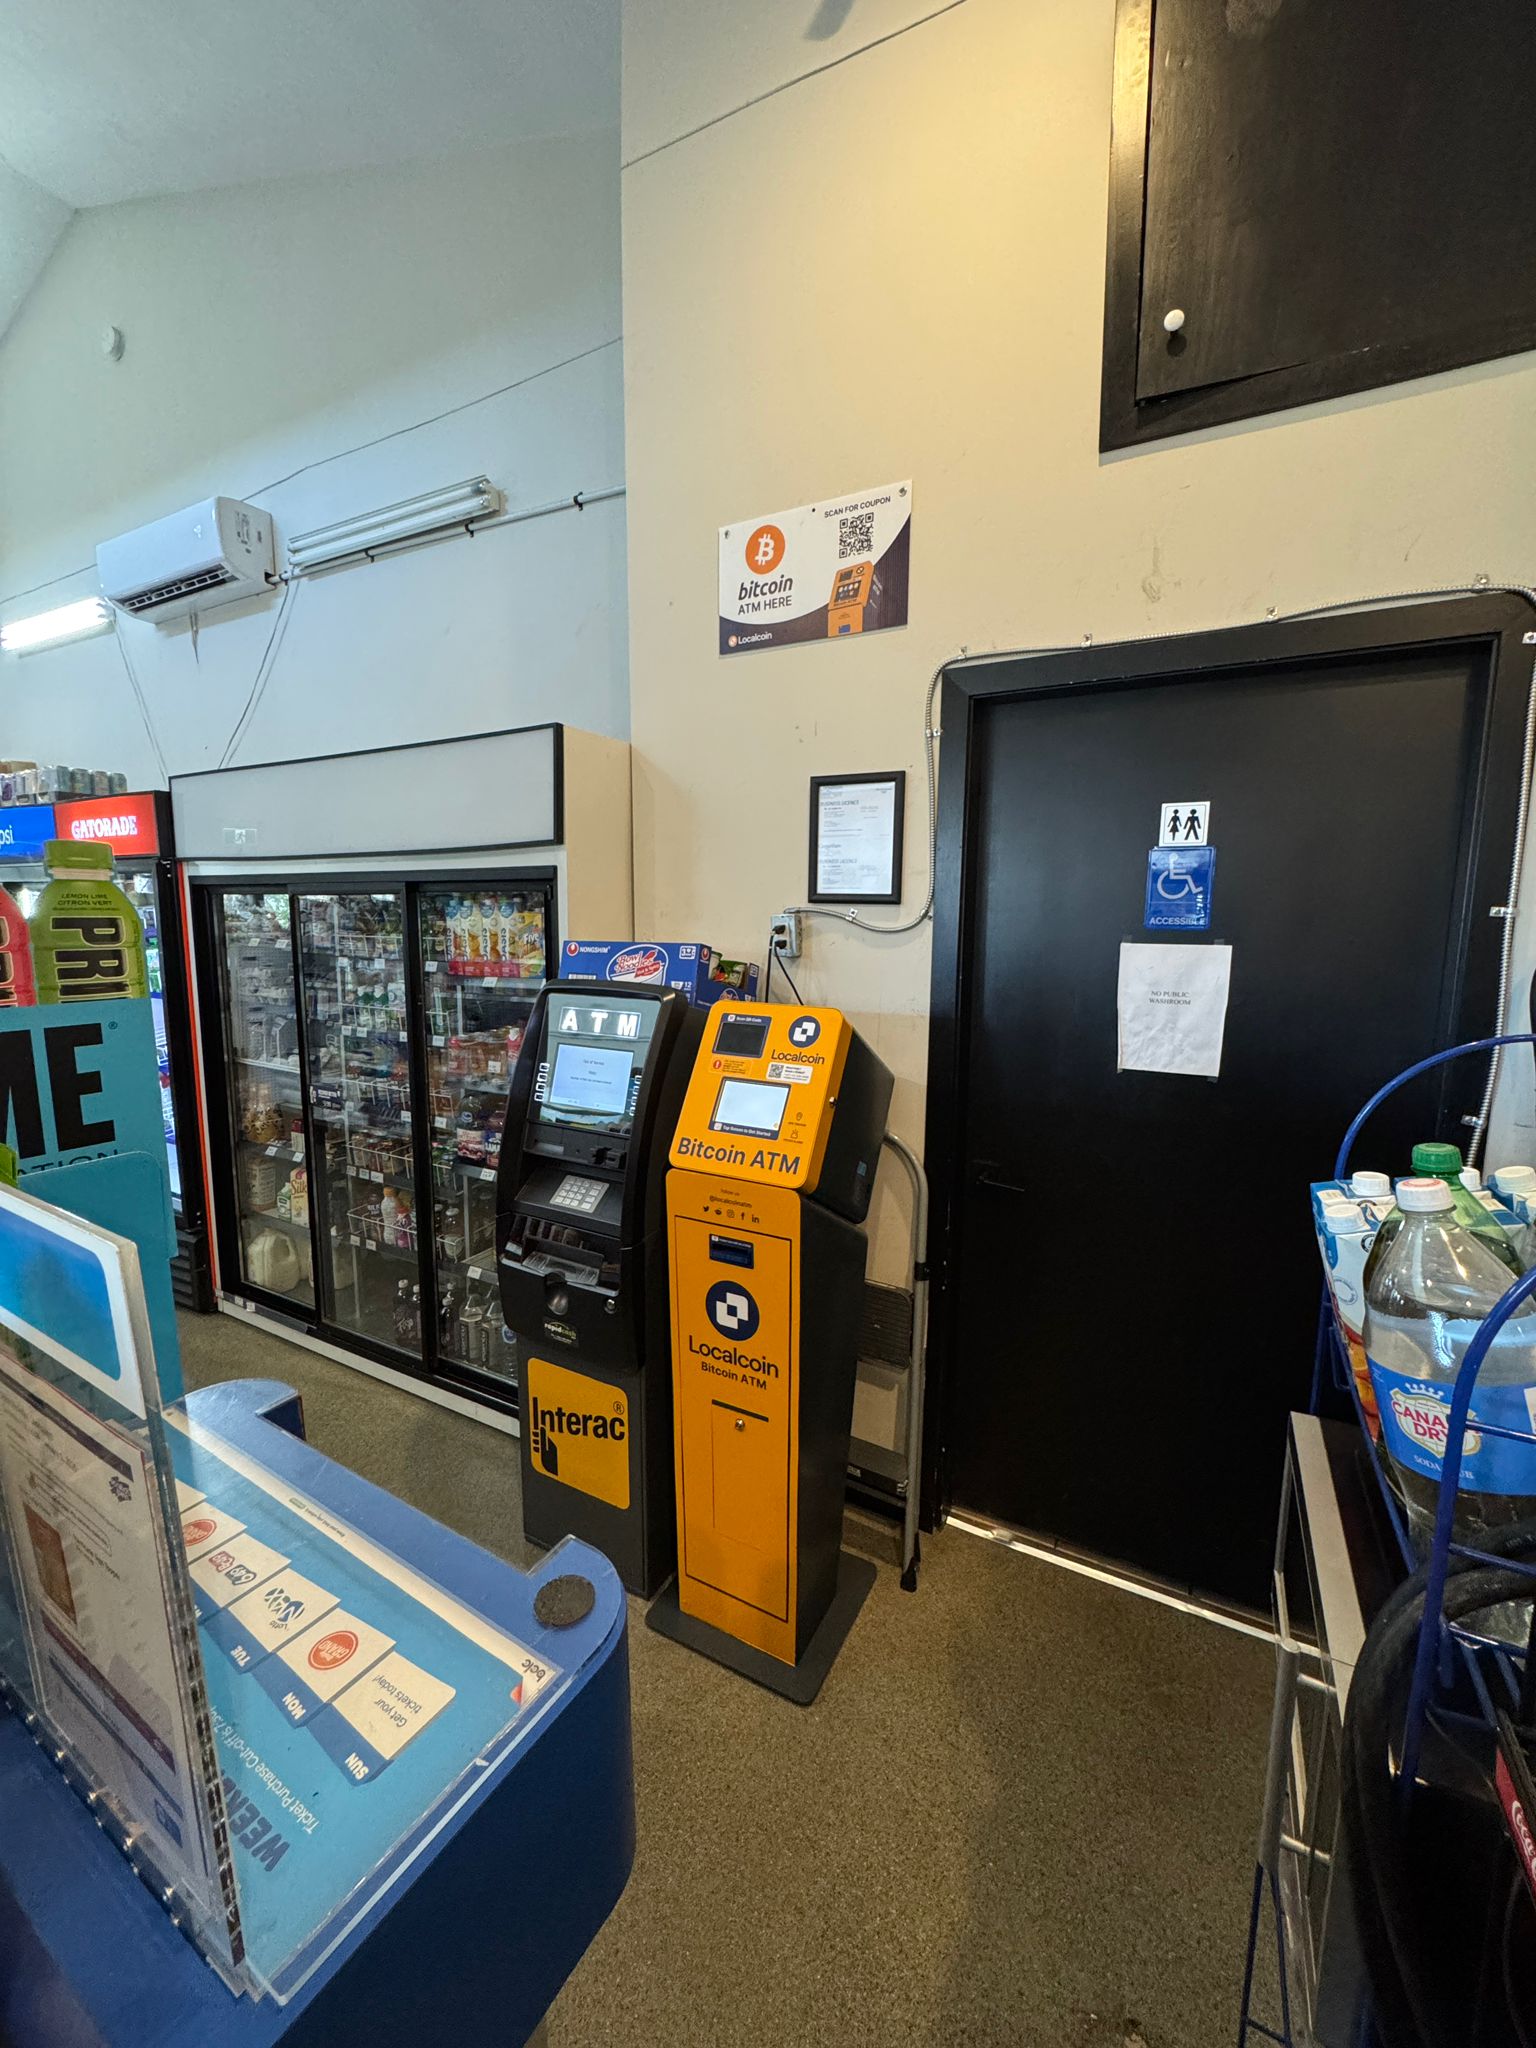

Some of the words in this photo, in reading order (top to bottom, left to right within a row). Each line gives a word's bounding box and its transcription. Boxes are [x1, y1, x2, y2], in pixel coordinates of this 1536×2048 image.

[824, 508, 844, 518] SCAN
[845, 504, 859, 513] FOR
[860, 496, 891, 509] COUPON
[738, 574, 793, 601] bitcoin
[738, 601, 762, 615] ATM
[764, 595, 792, 611] HERE
[738, 631, 772, 645] Localcoin
[71, 816, 138, 839] GATORADE
[1149, 917, 1206, 926] ACCESSIBLE
[579, 946, 609, 954] NONGSHIM
[617, 951, 643, 963] Bowl
[561, 1009, 639, 1038] ATM
[771, 1049, 825, 1065] Localcoin
[677, 1137, 746, 1165] Bitcoin
[750, 1150, 801, 1175] ATM
[688, 1334, 779, 1379] Localcoin
[701, 1360, 738, 1381] Bitcoin
[740, 1374, 767, 1391] ATM
[532, 1396, 625, 1441] Interac
[1392, 1401, 1448, 1430] CANA
[230, 1645, 251, 1667] TUE
[521, 1659, 546, 1682] bclc
[372, 1675, 398, 1696] today!
[282, 1691, 306, 1720] MON
[374, 1698, 395, 1717] your
[394, 1691, 422, 1715] tickets
[390, 1711, 407, 1728] Get
[228, 1735, 260, 1769] Cut-off
[345, 1752, 369, 1780] SUN
[255, 1762, 296, 1812] Purchase
[297, 1802, 320, 1835] Ticket
